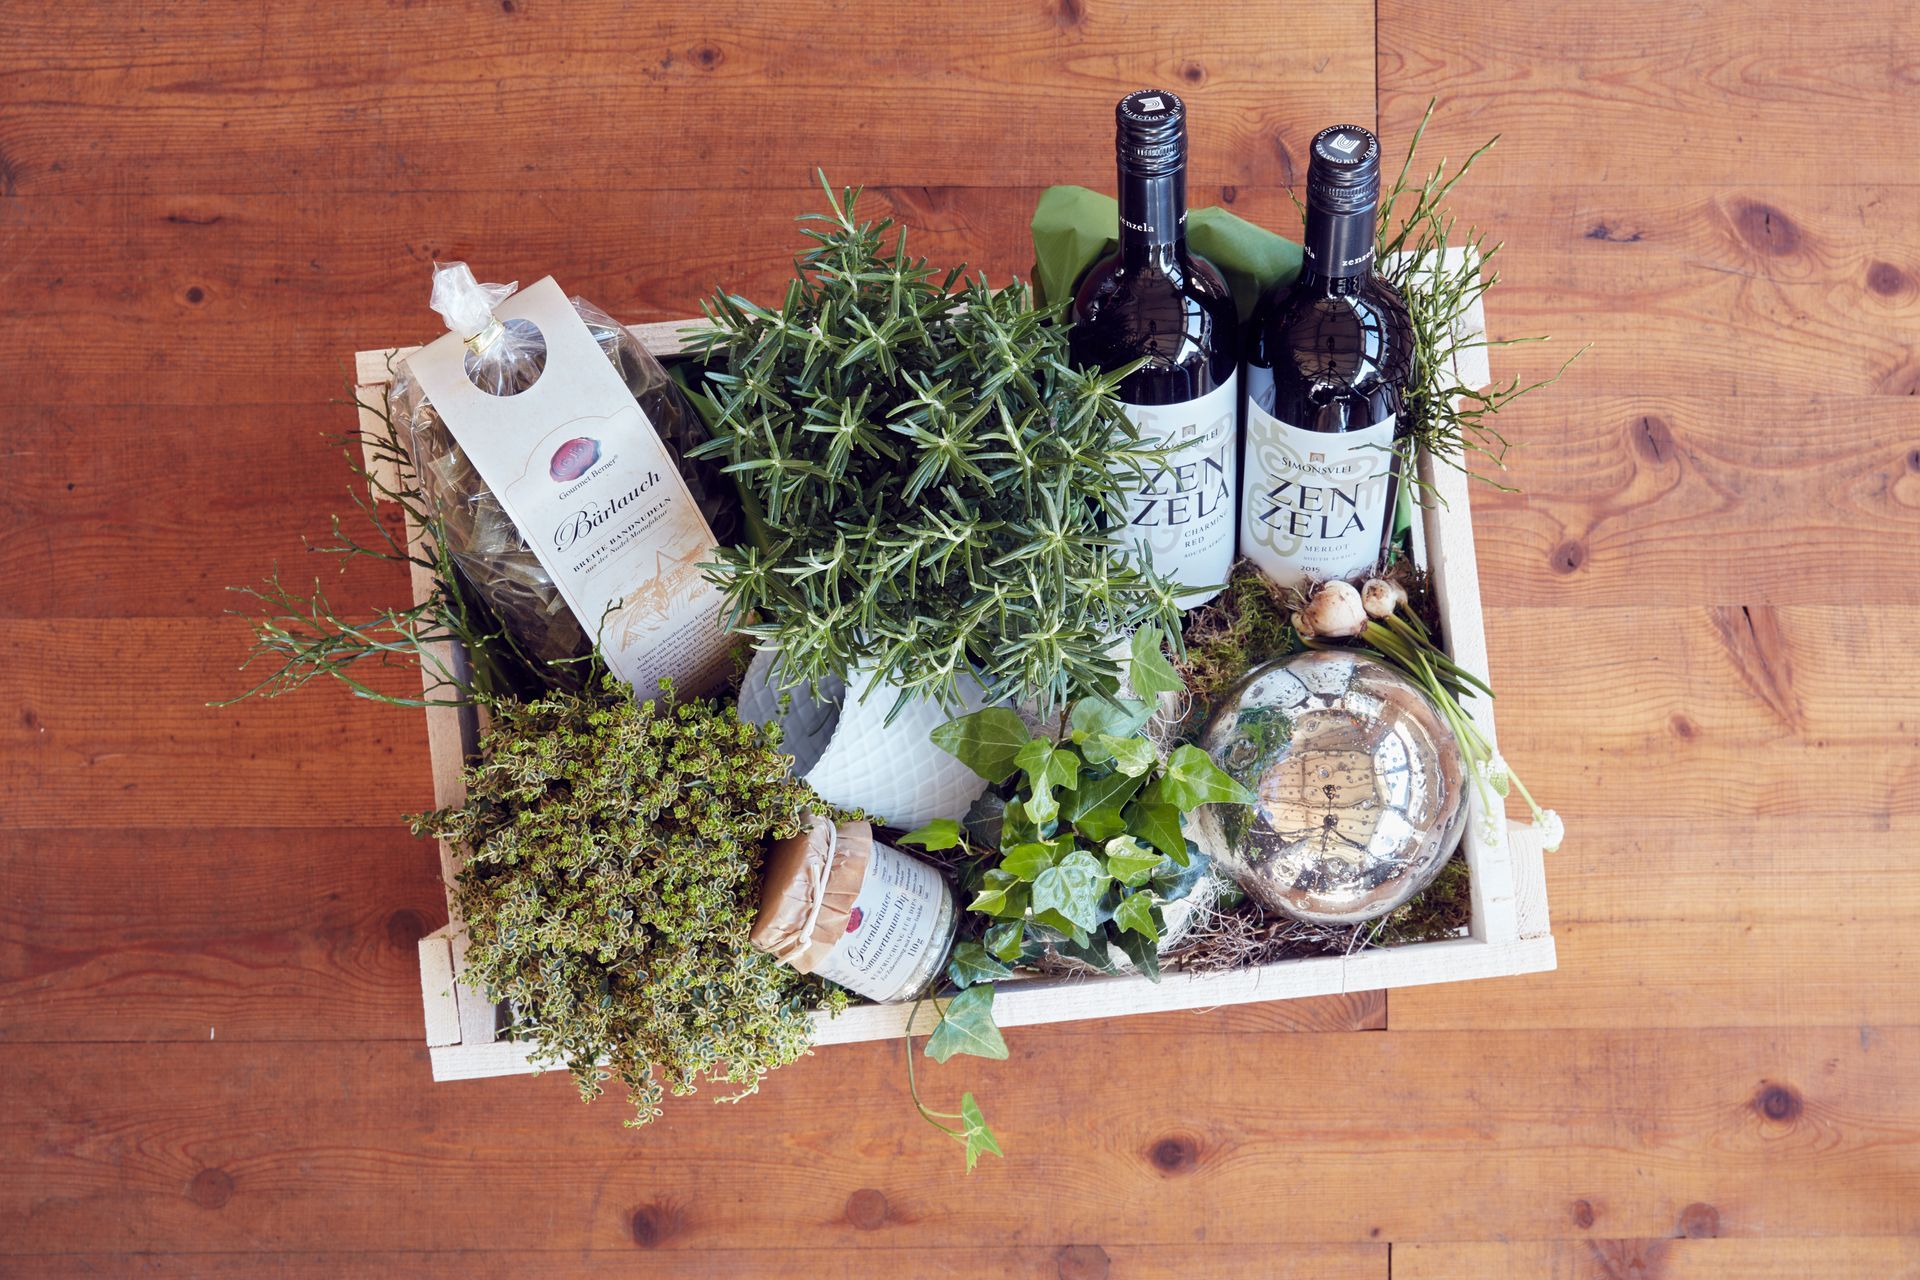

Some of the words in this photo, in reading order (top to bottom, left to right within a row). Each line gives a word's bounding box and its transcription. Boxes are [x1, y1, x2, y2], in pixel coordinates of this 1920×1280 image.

[1318, 124, 1367, 140] COLLECTION
[1315, 144, 1359, 164] SIMONSVLEI
[1139, 445, 1225, 495] ZEN
[1282, 456, 1352, 474] SIMONSVLEI
[558, 476, 591, 500] Gourmet
[1132, 477, 1230, 526] ZELA
[1266, 474, 1360, 512] ZEN
[554, 471, 662, 553] Bärlauch
[1258, 497, 1365, 539] ZELA
[574, 543, 607, 572] BREITE
[609, 496, 672, 544] BANDNUDELN
[1184, 536, 1205, 548] RED
[1304, 543, 1349, 552] MERLOT
[844, 890, 891, 967] Gartenkräuter-
[860, 890, 909, 974] Sommertraum-Dip
[907, 943, 919, 956] 110
